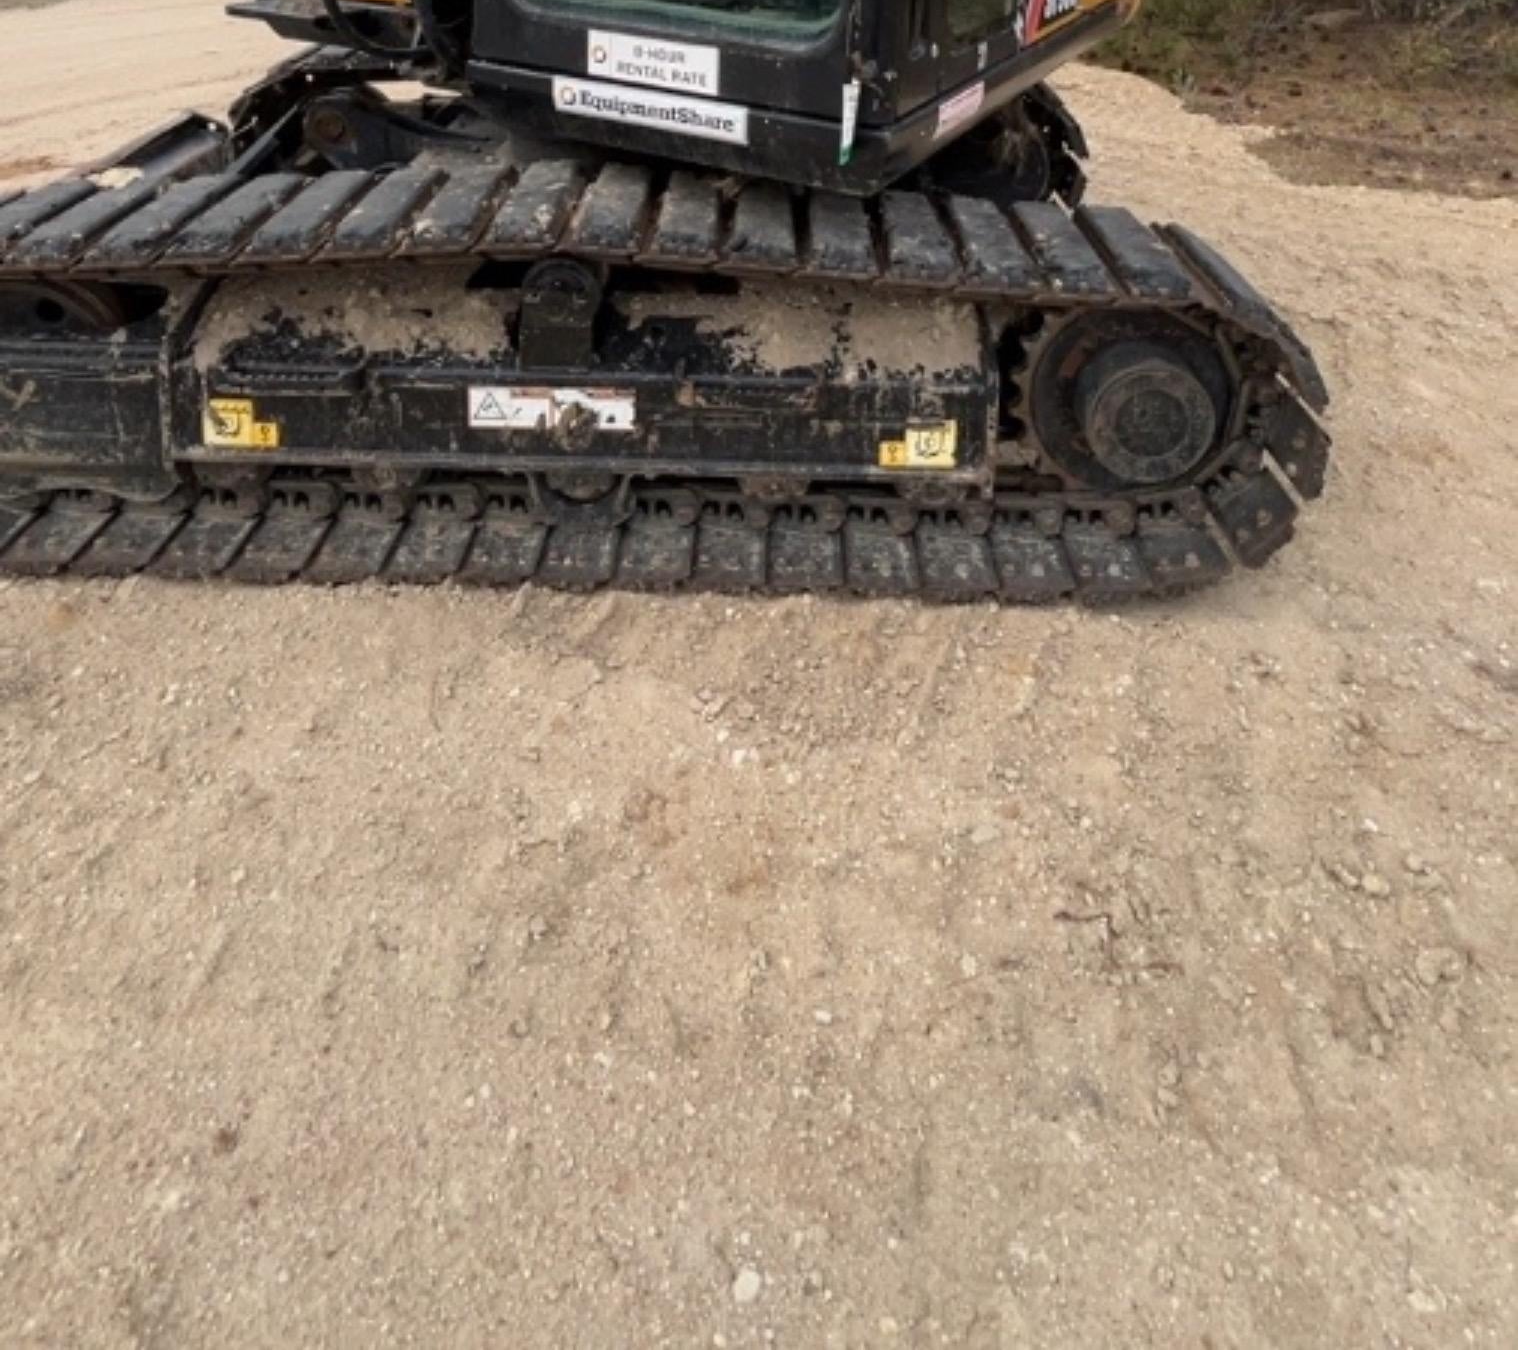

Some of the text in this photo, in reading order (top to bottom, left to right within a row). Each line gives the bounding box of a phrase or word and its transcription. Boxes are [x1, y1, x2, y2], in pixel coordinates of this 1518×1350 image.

[616, 61, 706, 87] RENTAL RATE
[580, 89, 733, 132] EquipmentShare
